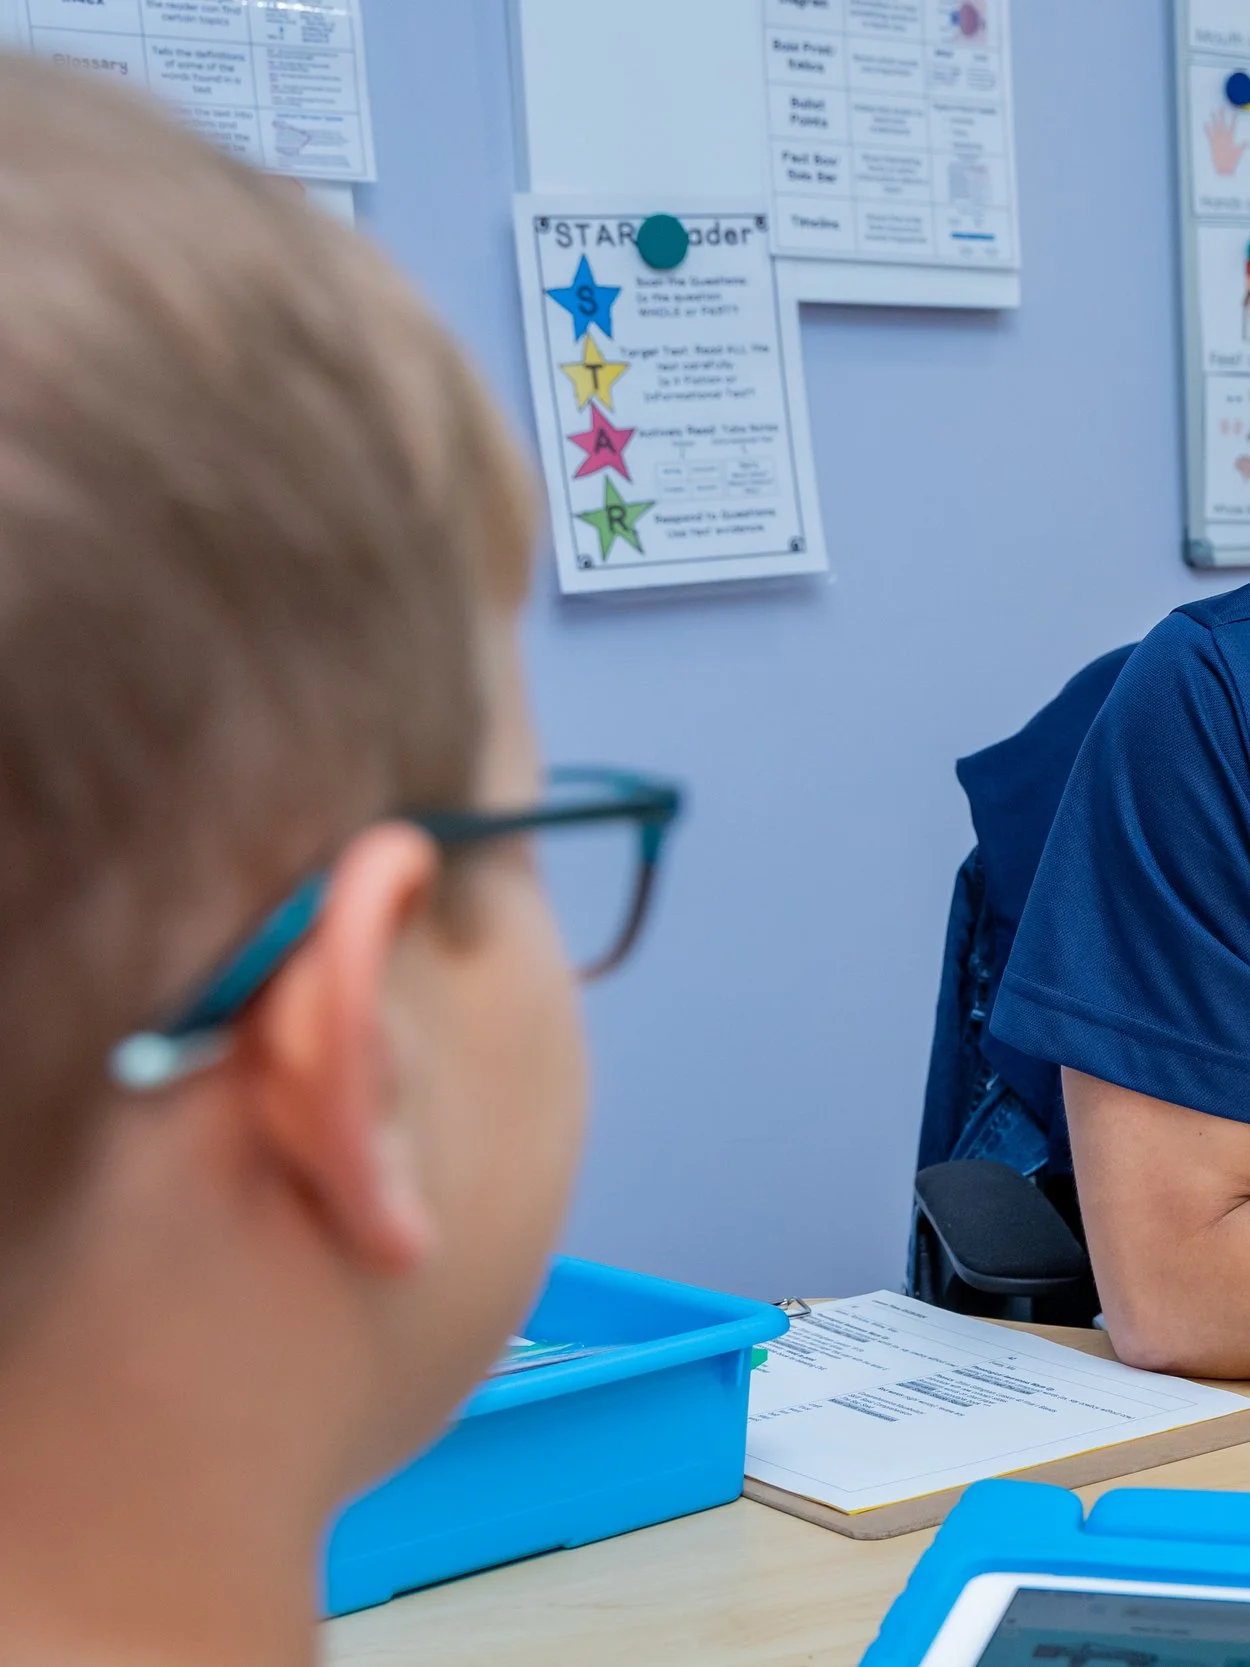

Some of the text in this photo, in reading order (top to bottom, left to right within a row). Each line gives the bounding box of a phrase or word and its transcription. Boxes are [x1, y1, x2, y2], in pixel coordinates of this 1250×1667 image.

[554, 221, 637, 248] STAR
[577, 285, 598, 316] S
[583, 363, 604, 390] T
[593, 428, 617, 456] A
[607, 504, 628, 533] R
